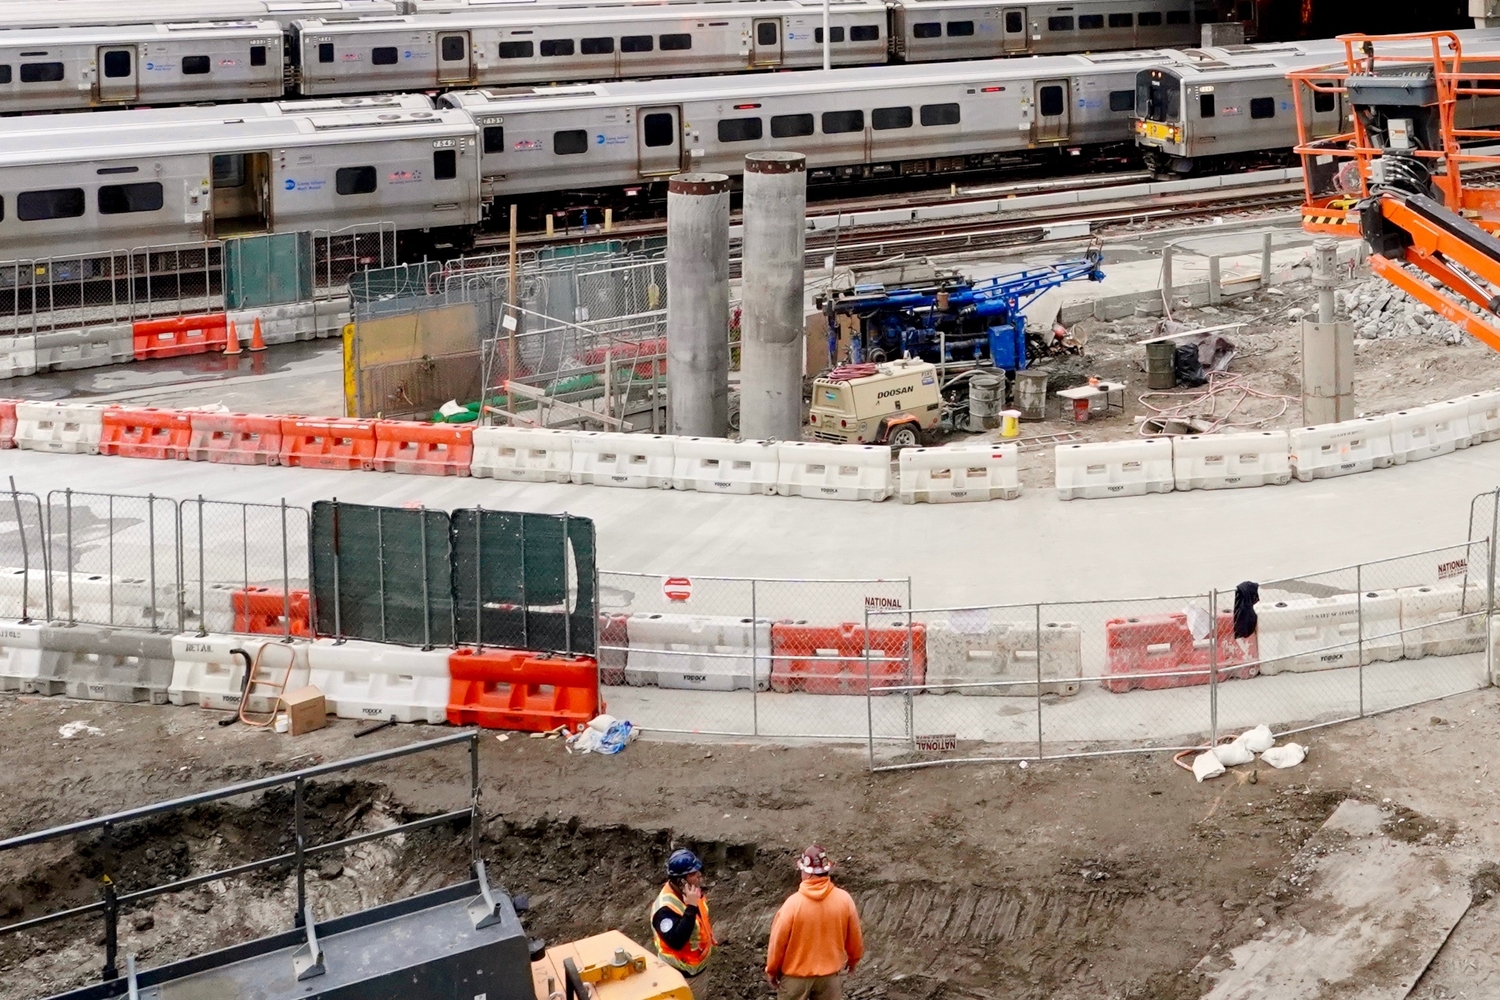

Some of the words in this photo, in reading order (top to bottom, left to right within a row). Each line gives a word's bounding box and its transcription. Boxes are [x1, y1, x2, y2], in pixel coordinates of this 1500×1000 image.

[877, 386, 914, 399] DOOSAN
[1438, 559, 1467, 572] NATIONAL
[865, 597, 902, 608] NATIONAL
[916, 741, 956, 750] NATIONAL
